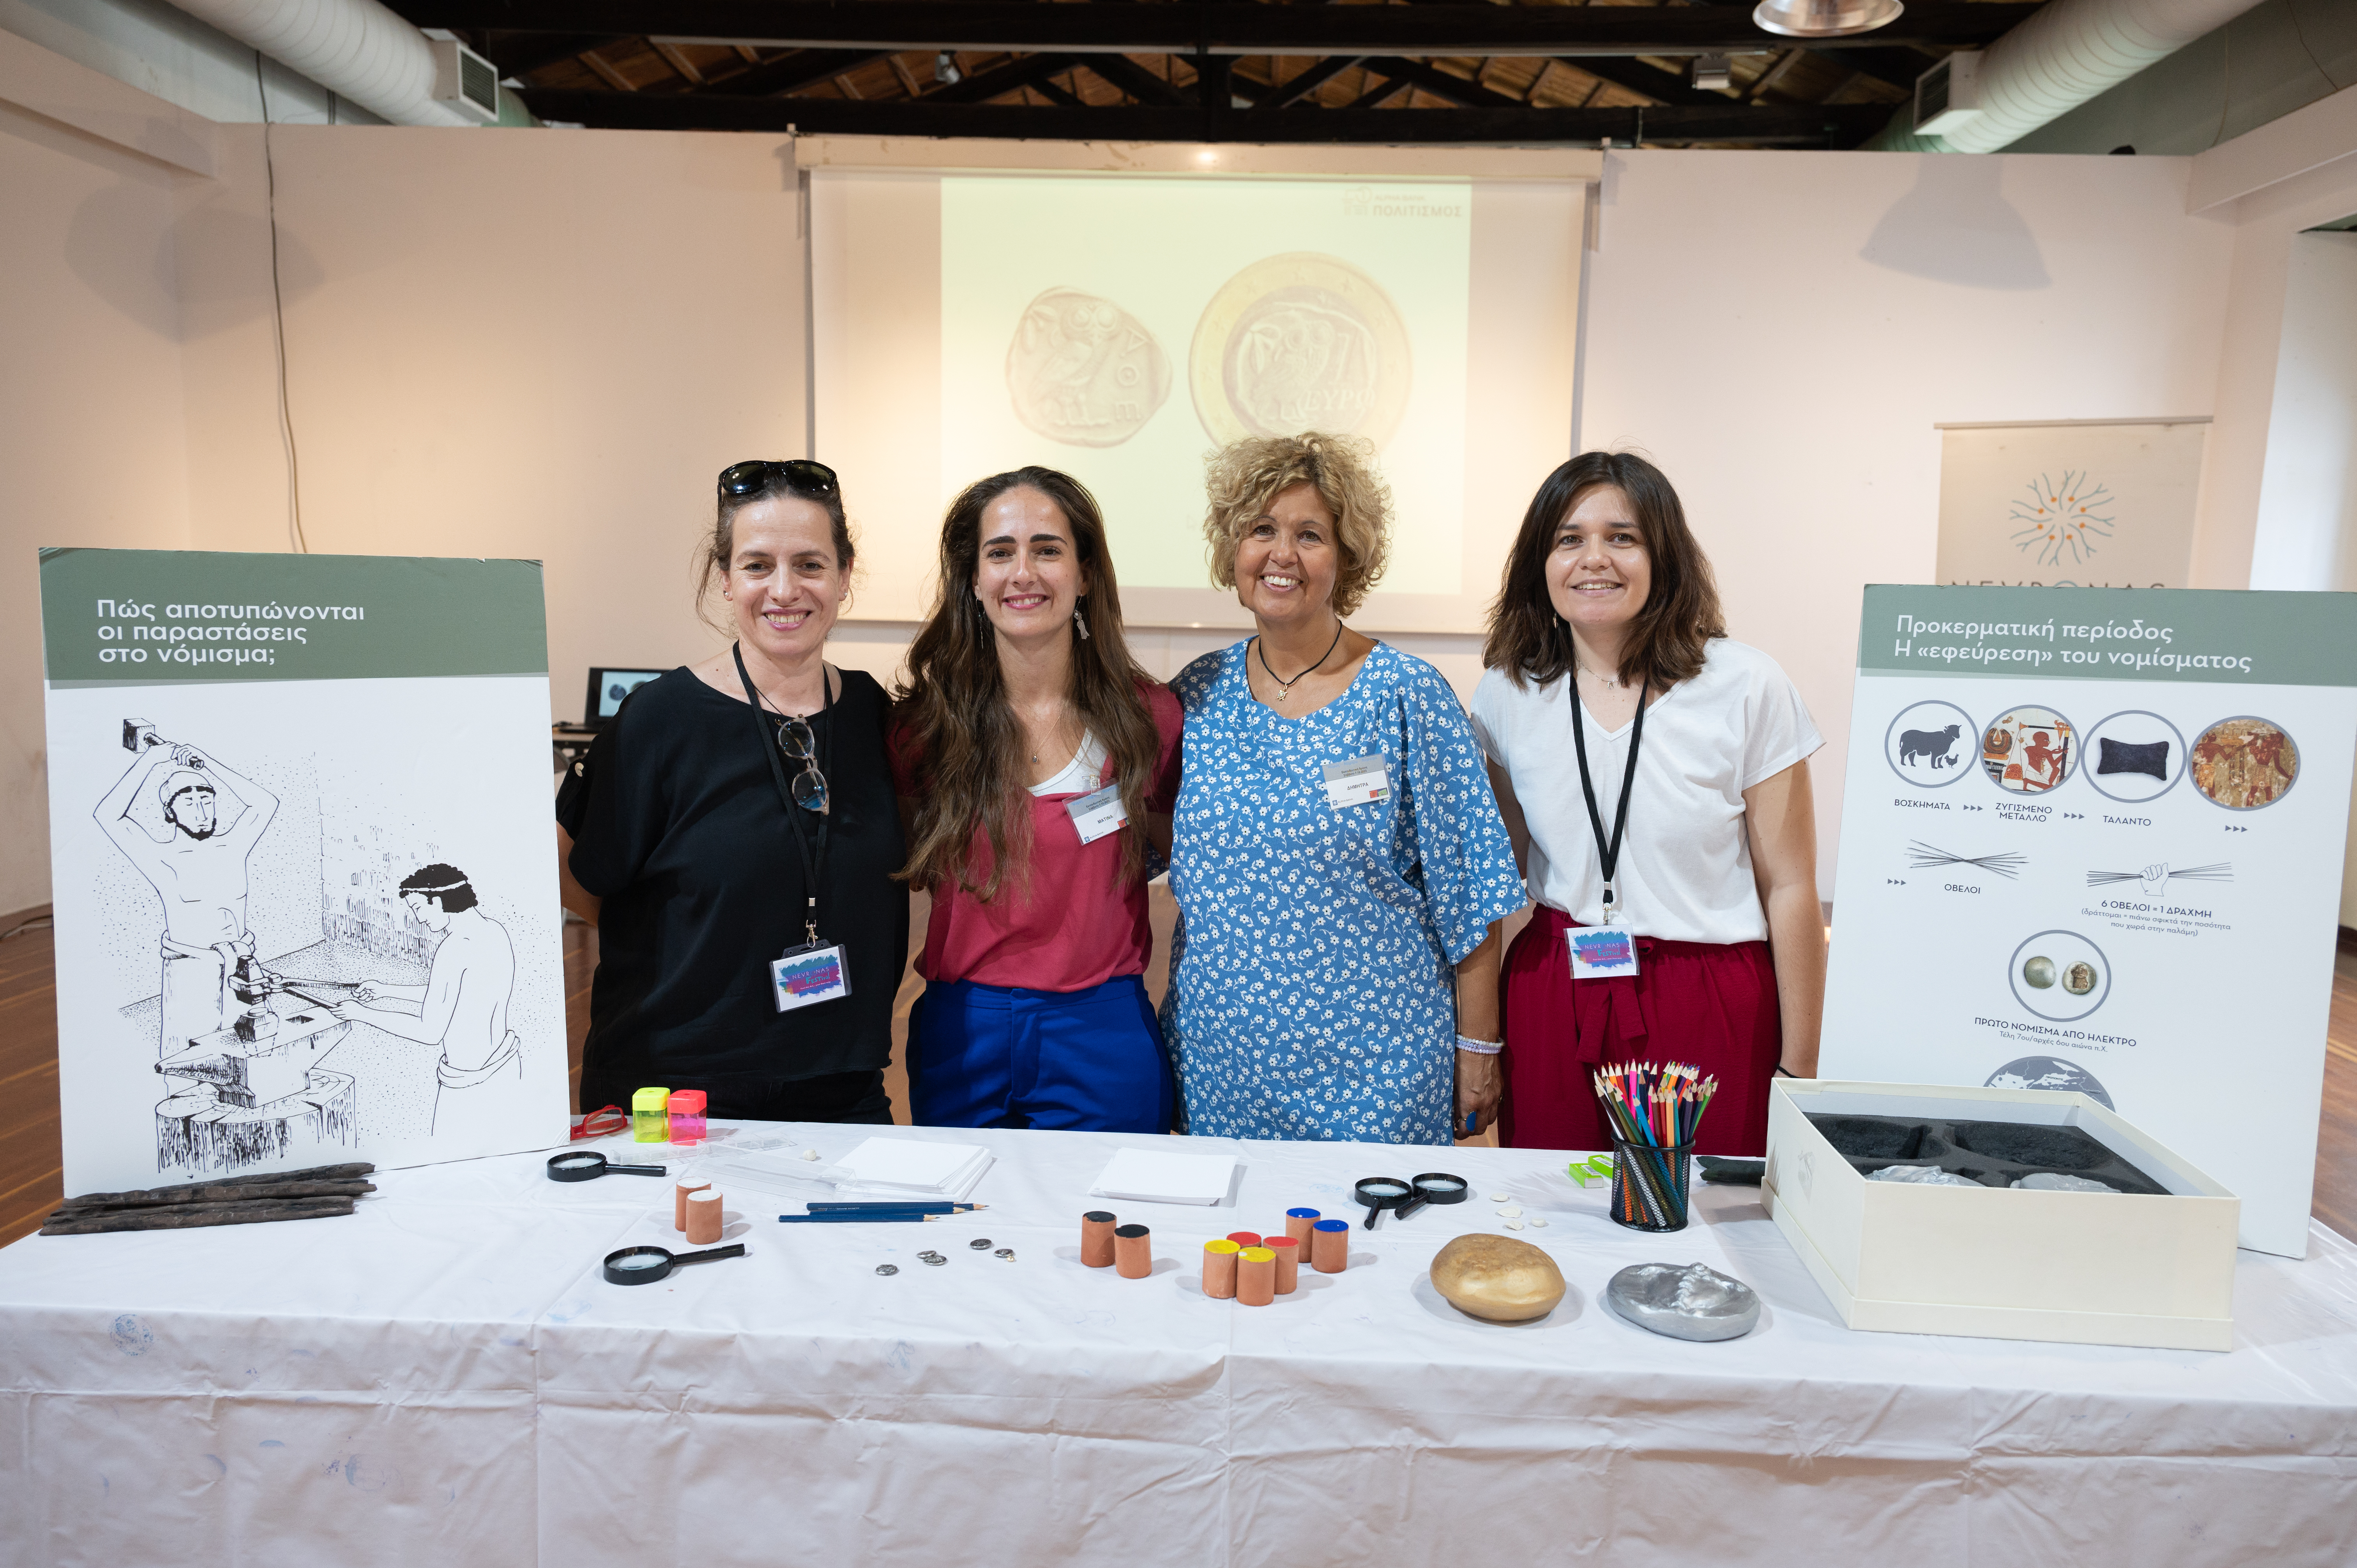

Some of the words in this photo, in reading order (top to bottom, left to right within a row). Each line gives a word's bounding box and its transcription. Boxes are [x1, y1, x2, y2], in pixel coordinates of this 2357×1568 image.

[1373, 205, 1461, 217] ΠΟΛΙΤΙΣΜΟΣ
[98, 599, 155, 621] Πώς
[166, 601, 364, 620] αποτυπώνονται
[98, 626, 122, 639] οι
[134, 622, 306, 644] παραστάσεις
[1898, 615, 2054, 642] Προκερματική
[2062, 620, 2173, 643] περίοδος
[99, 649, 147, 662] στο
[157, 643, 274, 666] νόμισμα;
[1895, 639, 1910, 656] Η
[1918, 642, 2052, 666] «εφεύρεση»
[2060, 651, 2099, 664] του
[2108, 647, 2252, 673] νομίσματος
[1894, 799, 1950, 810] ΒΟΣΚΗΜΑΤΑ
[1995, 803, 2052, 814] ΖΥΓΙΣΜΕΝΟ
[1999, 812, 2046, 822] ΜΕΤΑΛΛΟ
[2103, 815, 2151, 826] ΤΑΛΑΝΤΟ
[1944, 884, 1981, 894] ΟΒΕΛΟΙ
[2110, 901, 2150, 912] ΟΒΕΛΟΙ
[2166, 907, 2212, 918] ΔΡΑΧΜΗ
[2081, 908, 2122, 918] (δράττομαι
[2195, 922, 2231, 930] ποσότητα
[2167, 927, 2198, 937] παλάμη)
[1975, 1017, 2009, 1028] ΠΡΩΤΟ
[2011, 1023, 2059, 1036] ΝΟΜΙΣΜΑ
[2062, 1030, 2085, 1039] ΑΠΟ
[2088, 1033, 2136, 1046] ΗΛΕΚΤΡΟ
[2000, 1031, 2015, 1040] Τέλη
[2017, 1033, 2054, 1045] 7ου/αρχές
